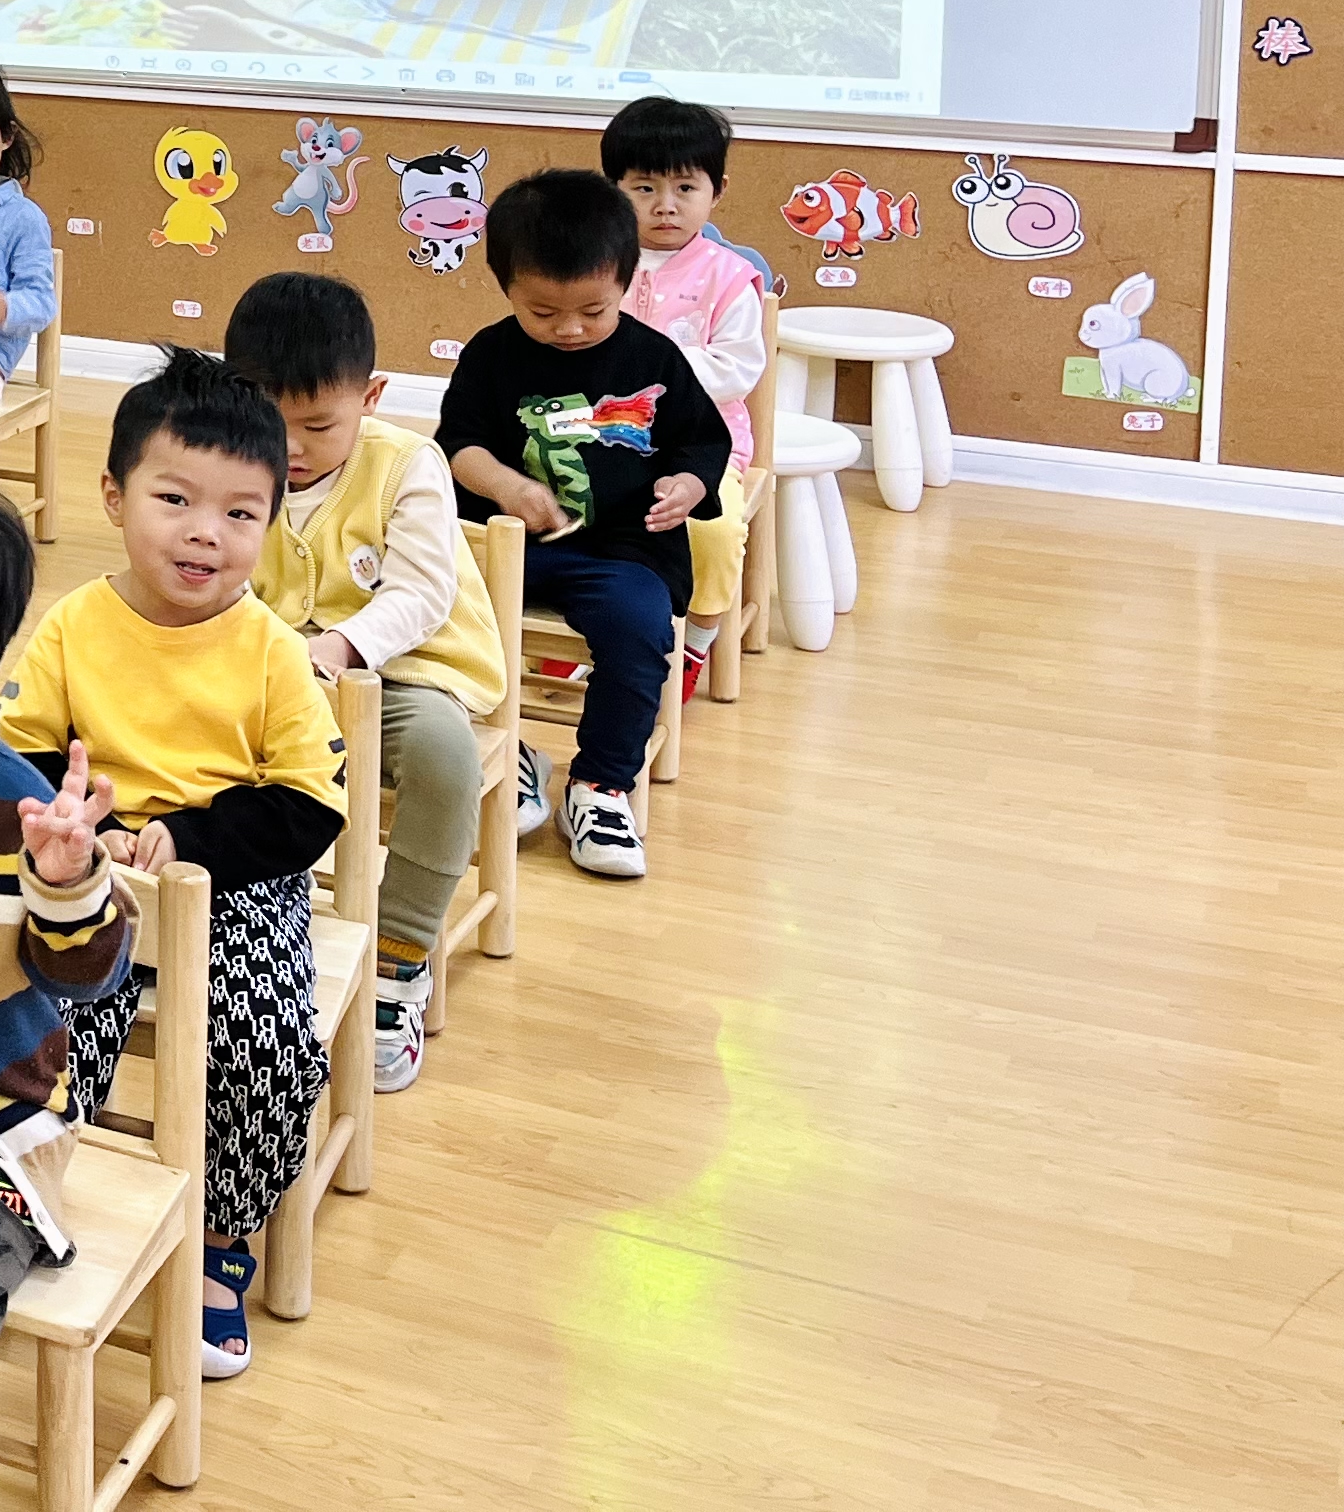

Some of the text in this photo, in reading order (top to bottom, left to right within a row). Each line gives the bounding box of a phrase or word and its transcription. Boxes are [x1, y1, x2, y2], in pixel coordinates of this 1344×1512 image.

[301, 236, 329, 249] 老鼠
[820, 269, 852, 283] 金鱼
[1033, 281, 1069, 296] 蜗牛
[174, 302, 200, 315] 鸭子
[433, 342, 461, 357] 奶牛
[1126, 415, 1161, 429] 兔子
